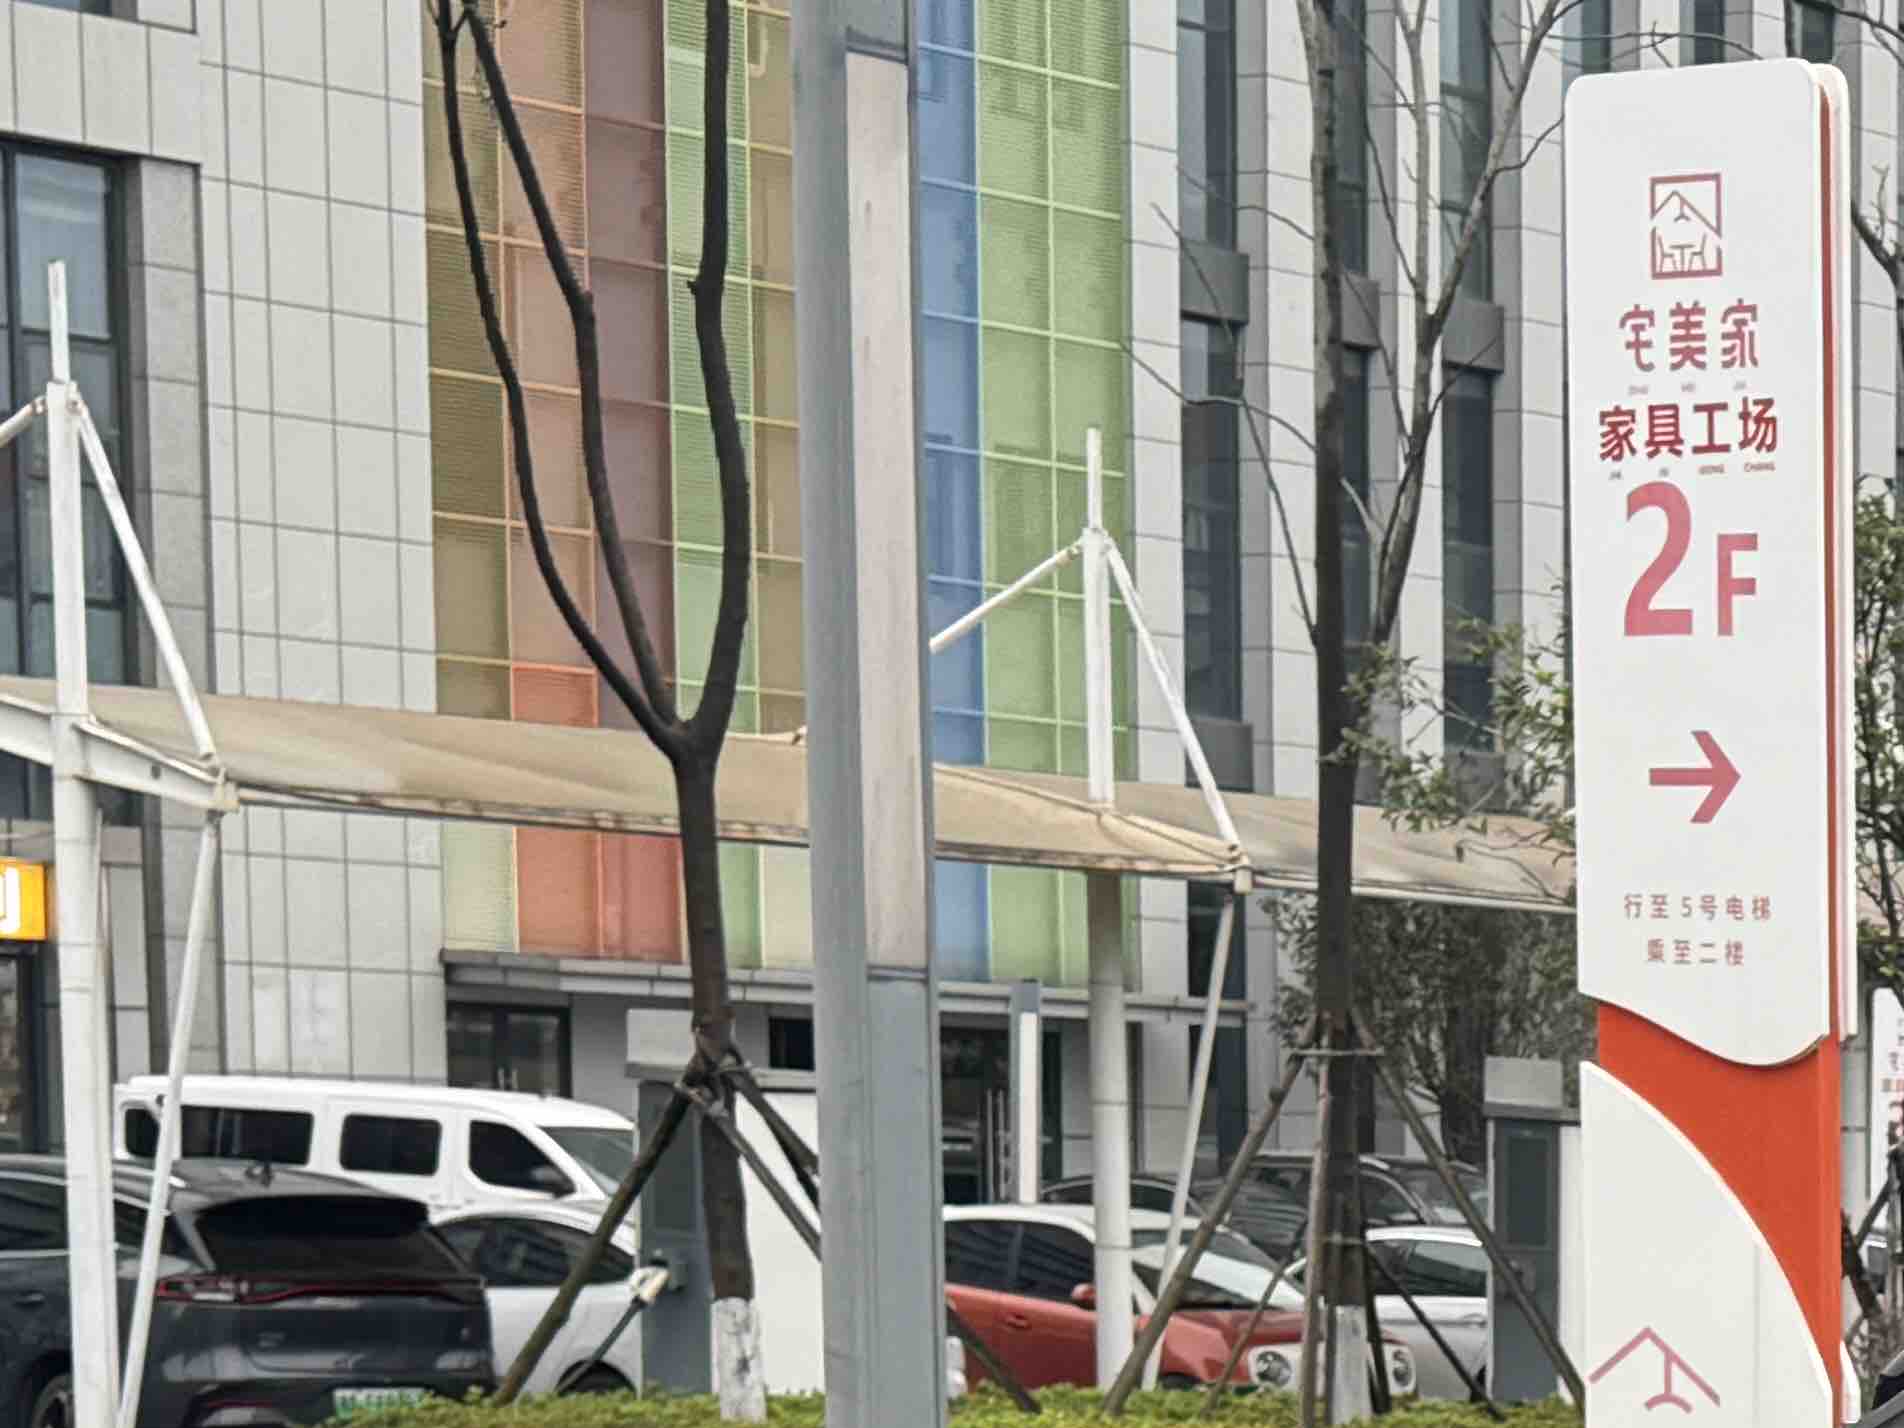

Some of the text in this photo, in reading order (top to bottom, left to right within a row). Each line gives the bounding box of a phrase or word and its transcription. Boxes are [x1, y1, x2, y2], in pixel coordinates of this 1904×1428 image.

[1619, 297, 1759, 372] 宅美家
[1599, 396, 1777, 462] 家具工场
[1624, 481, 1758, 637] 2F
